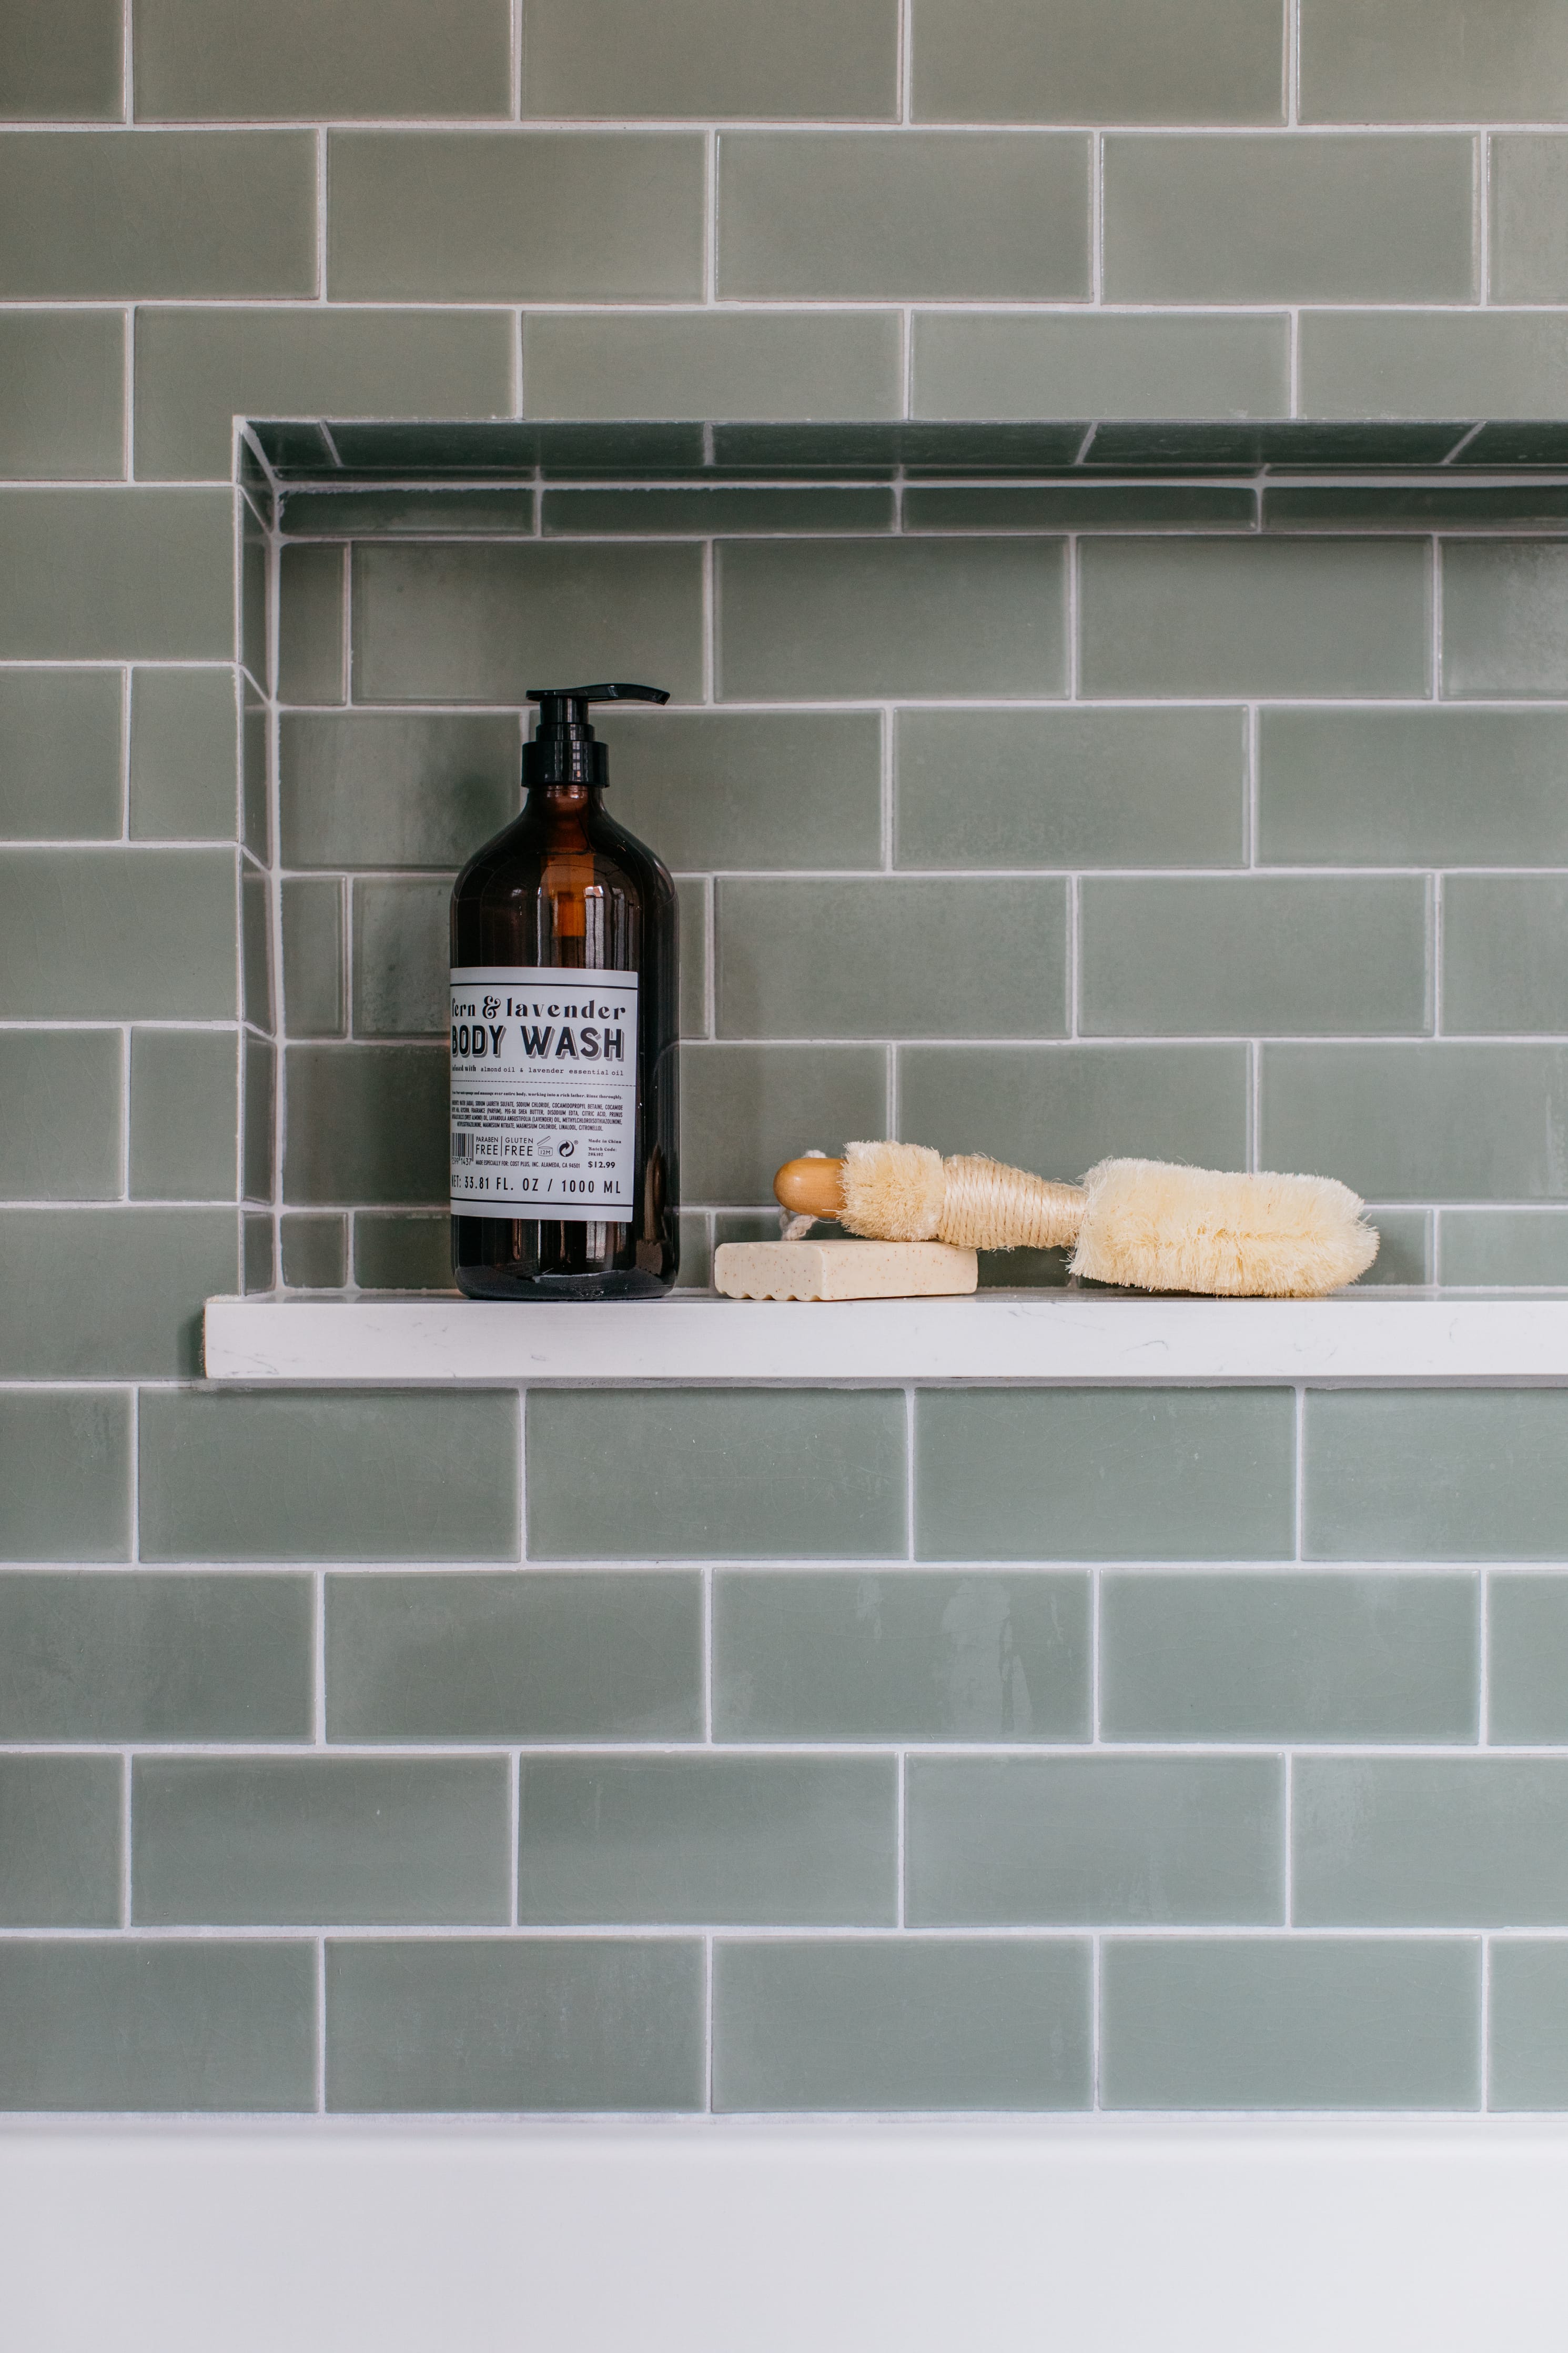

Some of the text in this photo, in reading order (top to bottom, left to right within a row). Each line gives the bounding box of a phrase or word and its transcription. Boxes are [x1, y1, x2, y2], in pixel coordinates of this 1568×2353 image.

[452, 996, 626, 1020] fern & lavender
[452, 1025, 625, 1062] BODY WASH
[476, 1144, 498, 1155] FREE
[505, 1145, 533, 1156] FREE
[465, 1176, 489, 1189] 33.81
[497, 1177, 513, 1190] FL.
[523, 1178, 539, 1191] OZ
[562, 1180, 594, 1193] 1000
[604, 1181, 621, 1193] ML
